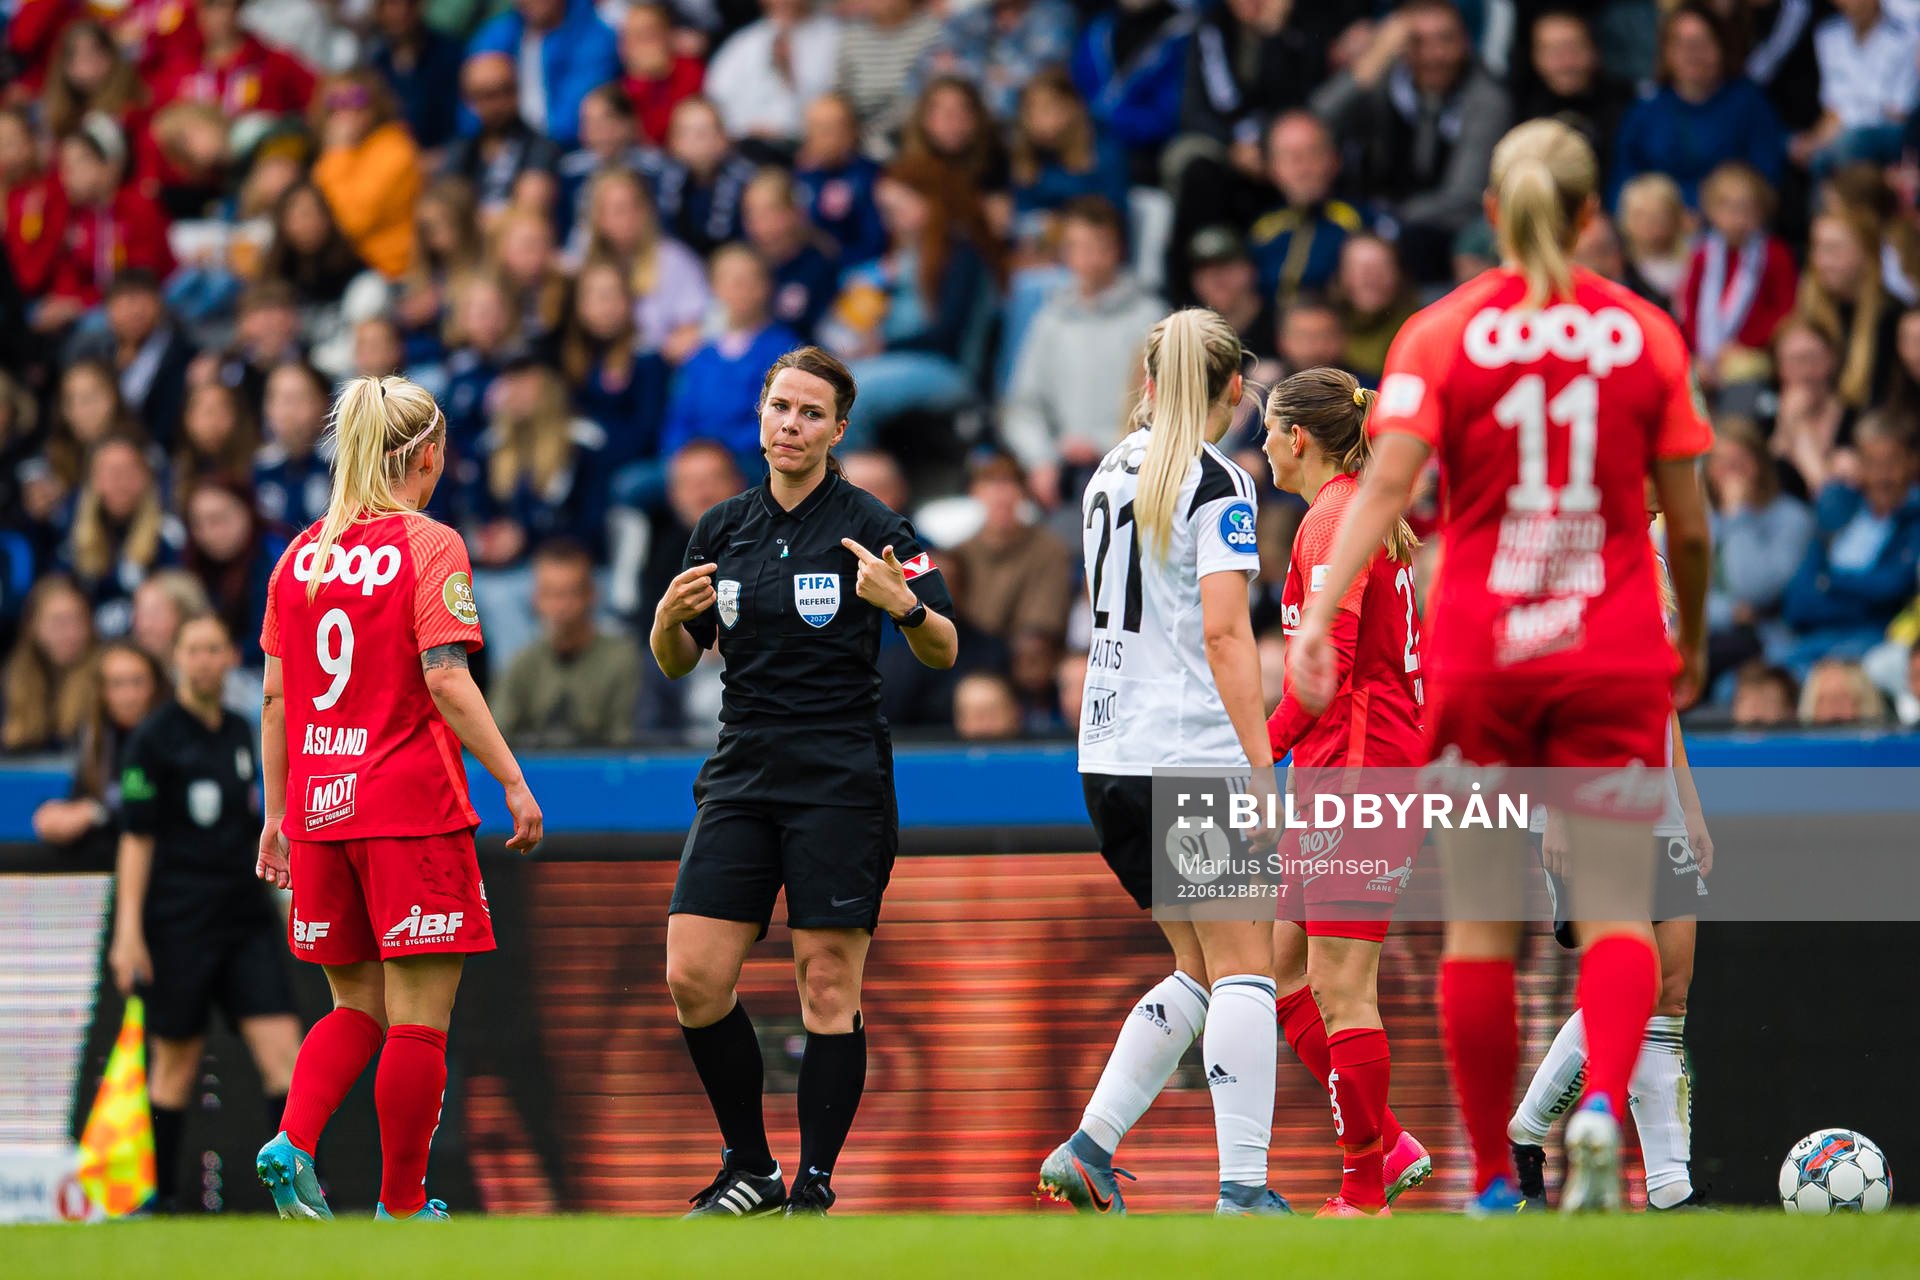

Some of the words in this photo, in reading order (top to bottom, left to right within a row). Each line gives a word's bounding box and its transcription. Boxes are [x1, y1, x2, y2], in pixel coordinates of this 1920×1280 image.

[1463, 305, 1644, 377] coop
[1493, 373, 1601, 512] 11
[293, 542, 402, 596] coop
[1086, 491, 1144, 633] 21
[798, 576, 835, 590] FIFA
[799, 597, 836, 606] REFEREE
[810, 615, 828, 623] 2022
[312, 608, 354, 711] 9
[302, 723, 368, 756] ÅSLAND
[312, 773, 357, 812] MOT
[294, 914, 330, 943] BF
[383, 904, 464, 940] ÅBF
[405, 935, 455, 946] BYGGMESTER
